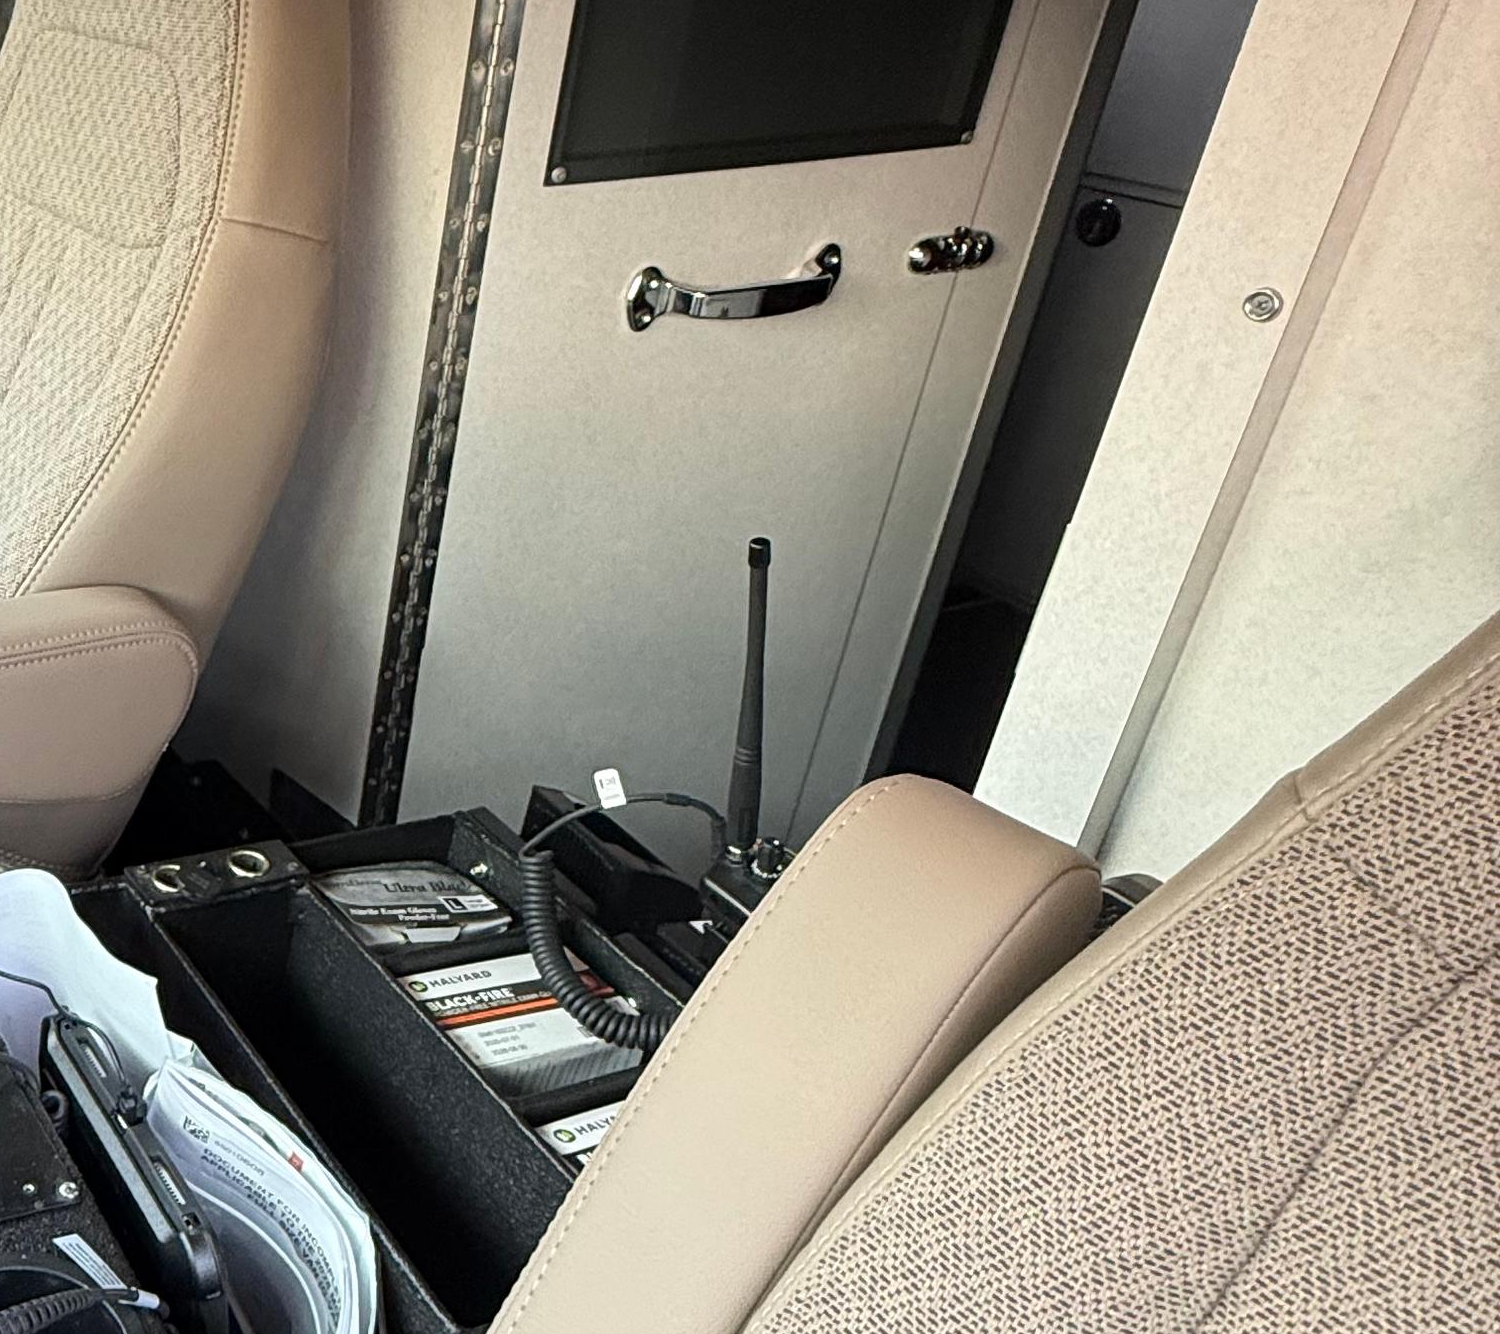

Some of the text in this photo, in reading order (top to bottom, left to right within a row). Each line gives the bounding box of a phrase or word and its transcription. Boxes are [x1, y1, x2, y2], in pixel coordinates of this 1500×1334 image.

[428, 970, 492, 988] HALYARD
[574, 1115, 616, 1135] HALY
[201, 1155, 277, 1211] APPLICABLE
[280, 1211, 295, 1228] TO
[297, 1229, 315, 1255] THE
[203, 1148, 274, 1198] DOCUMENT
[277, 1198, 301, 1223] FOR
